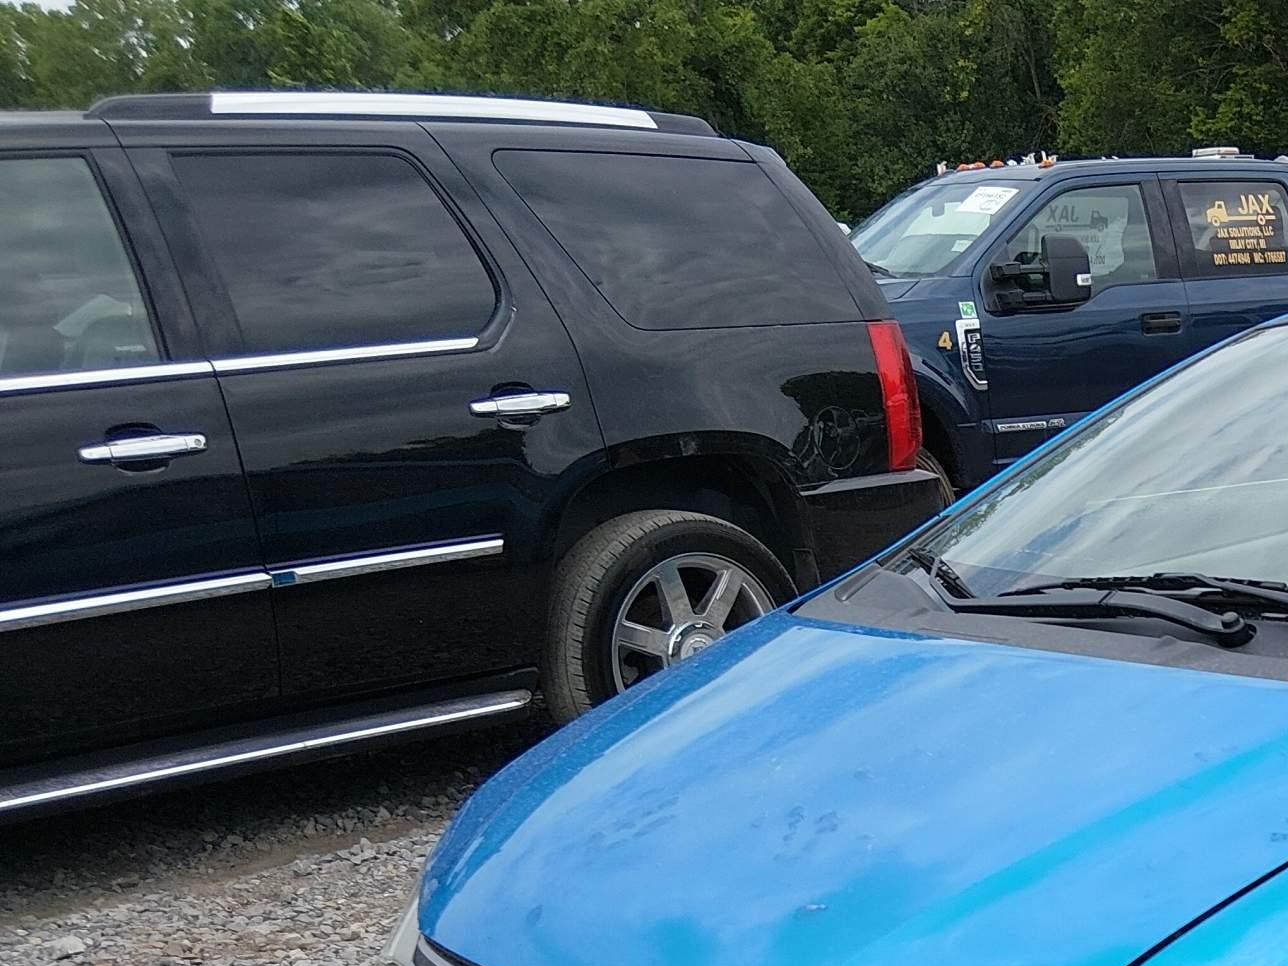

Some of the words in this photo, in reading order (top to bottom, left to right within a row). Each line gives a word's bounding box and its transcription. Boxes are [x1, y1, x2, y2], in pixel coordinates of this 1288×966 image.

[1238, 194, 1274, 215] JAX
[1216, 226, 1229, 238] JAX
[1229, 226, 1263, 238] SOLUTIONS,
[1263, 225, 1274, 236] LLC
[1245, 238, 1260, 250] CITY,
[1213, 253, 1228, 266] DOT:
[938, 331, 953, 350] 4
